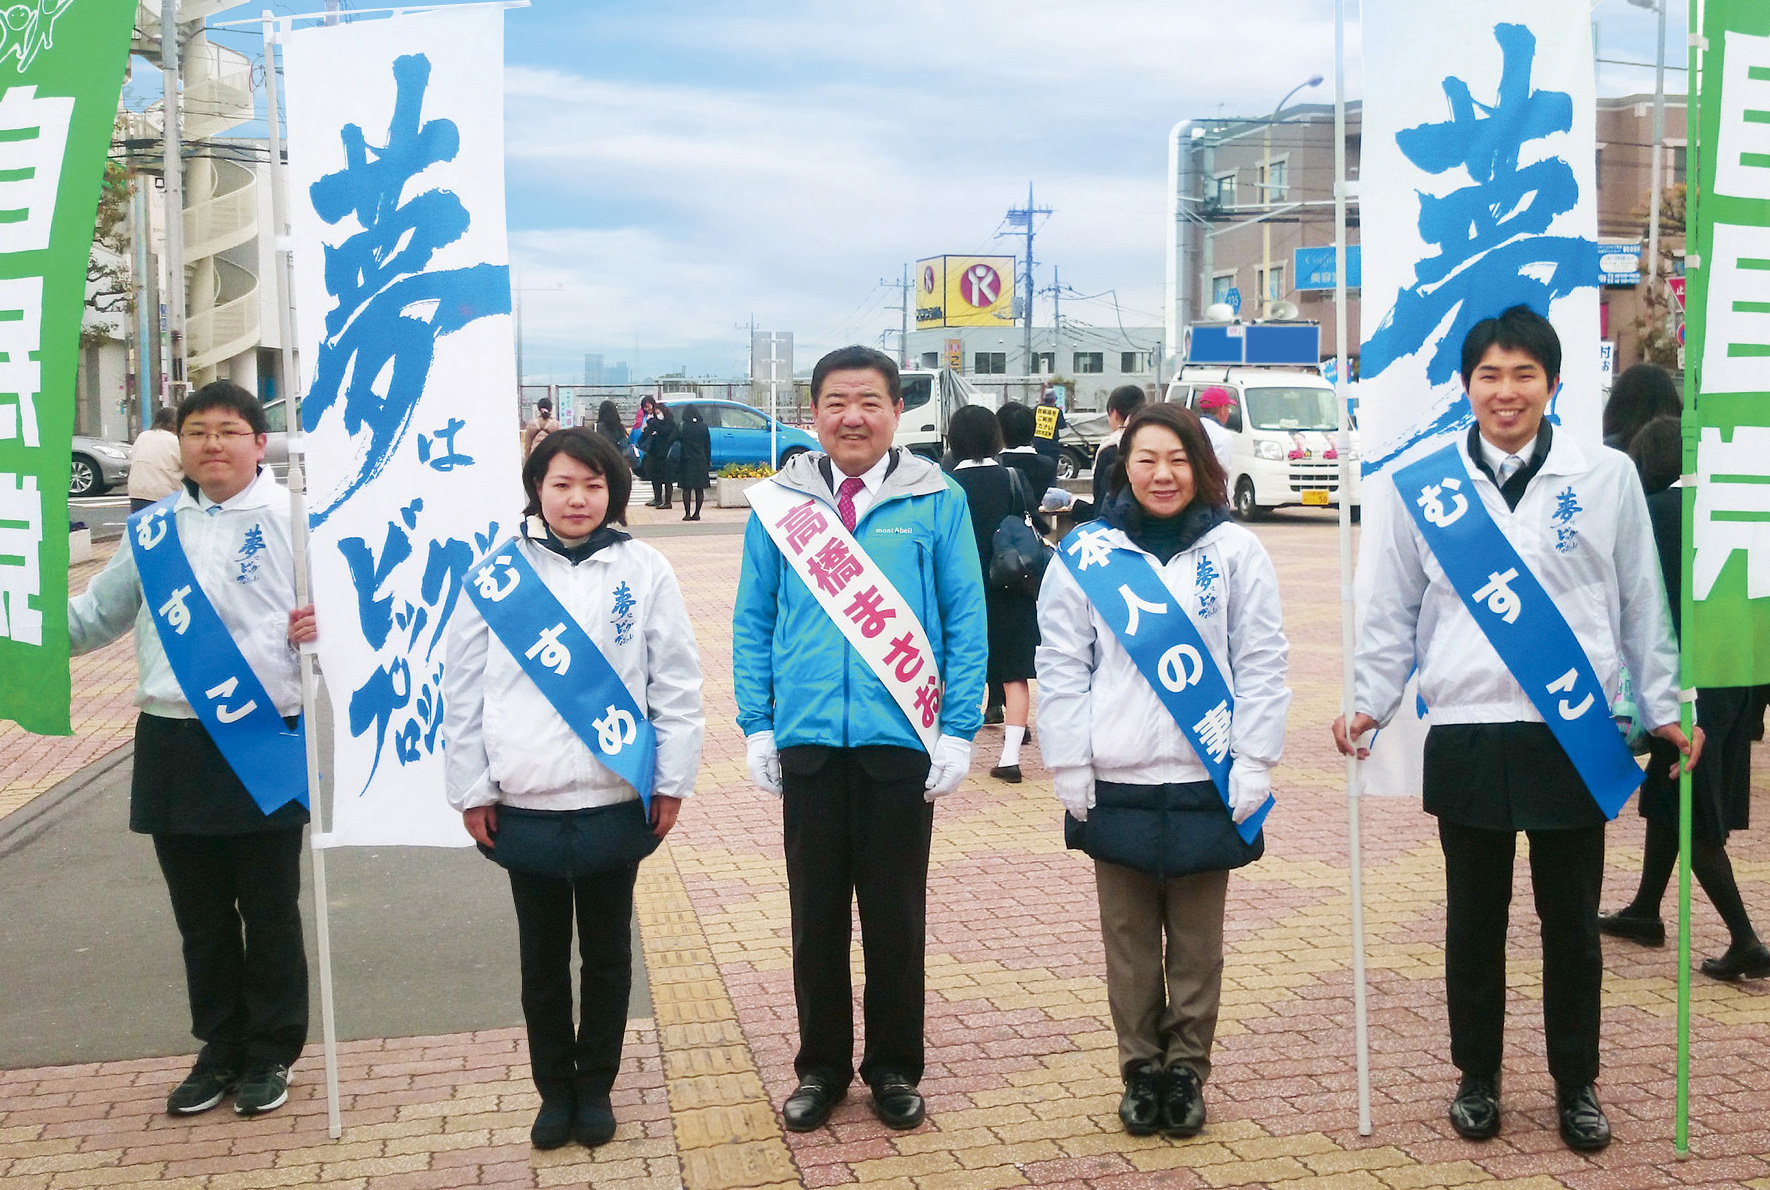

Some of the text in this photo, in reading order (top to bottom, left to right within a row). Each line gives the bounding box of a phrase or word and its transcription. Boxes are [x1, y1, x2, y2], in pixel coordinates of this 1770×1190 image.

[136, 507, 257, 724] むすこ
[473, 555, 637, 756] むすめ
[775, 499, 940, 728] 高橋まさお
[1067, 527, 1233, 764] 本人の妻
[1416, 477, 1594, 720] むすこ
